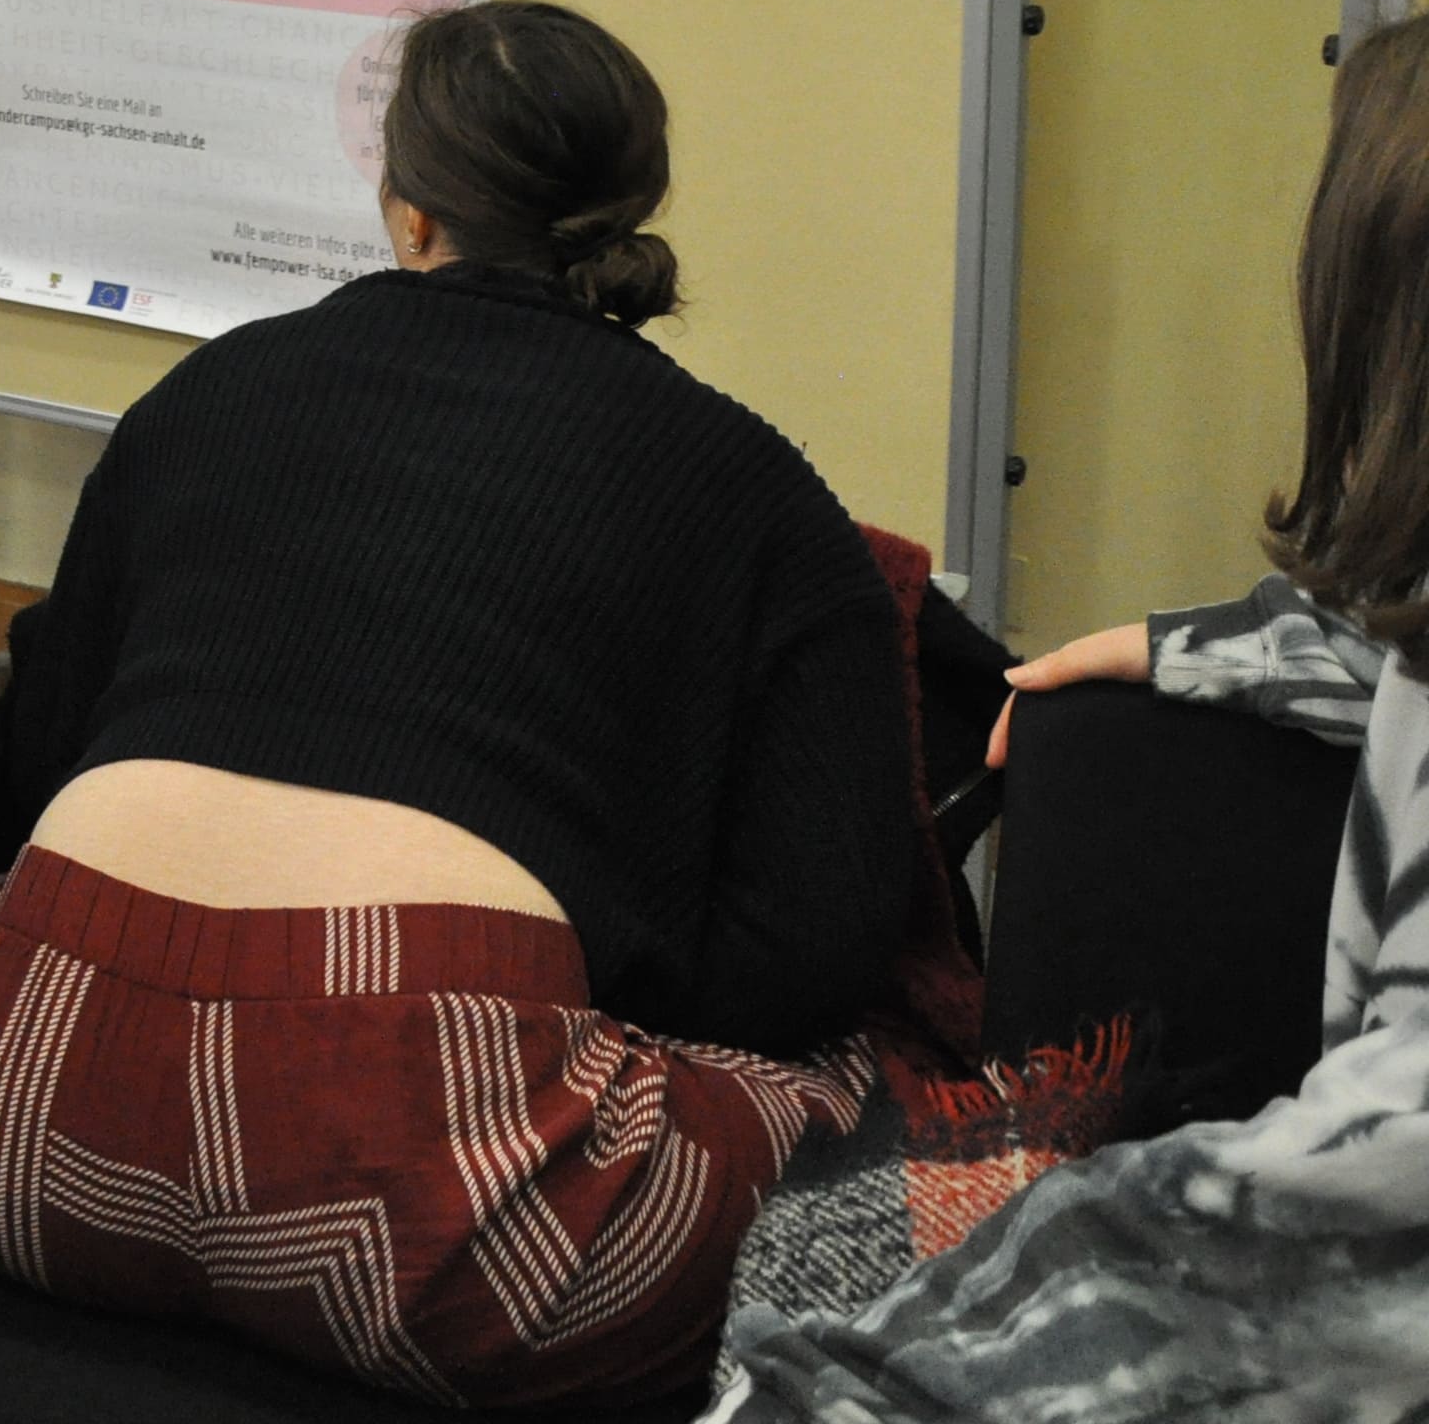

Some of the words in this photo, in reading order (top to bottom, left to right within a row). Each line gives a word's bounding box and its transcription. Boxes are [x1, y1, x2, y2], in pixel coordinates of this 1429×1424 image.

[21, 83, 74, 105] Schreiben
[76, 91, 94, 109] Sie
[97, 95, 120, 111] eine
[123, 97, 146, 115] Mail
[148, 103, 162, 118] an
[233, 221, 257, 241] Alle
[259, 228, 314, 249] weiteren
[316, 235, 348, 256] Infos
[350, 241, 376, 261] gibt
[379, 248, 393, 262] es
[132, 294, 153, 305] ESF
